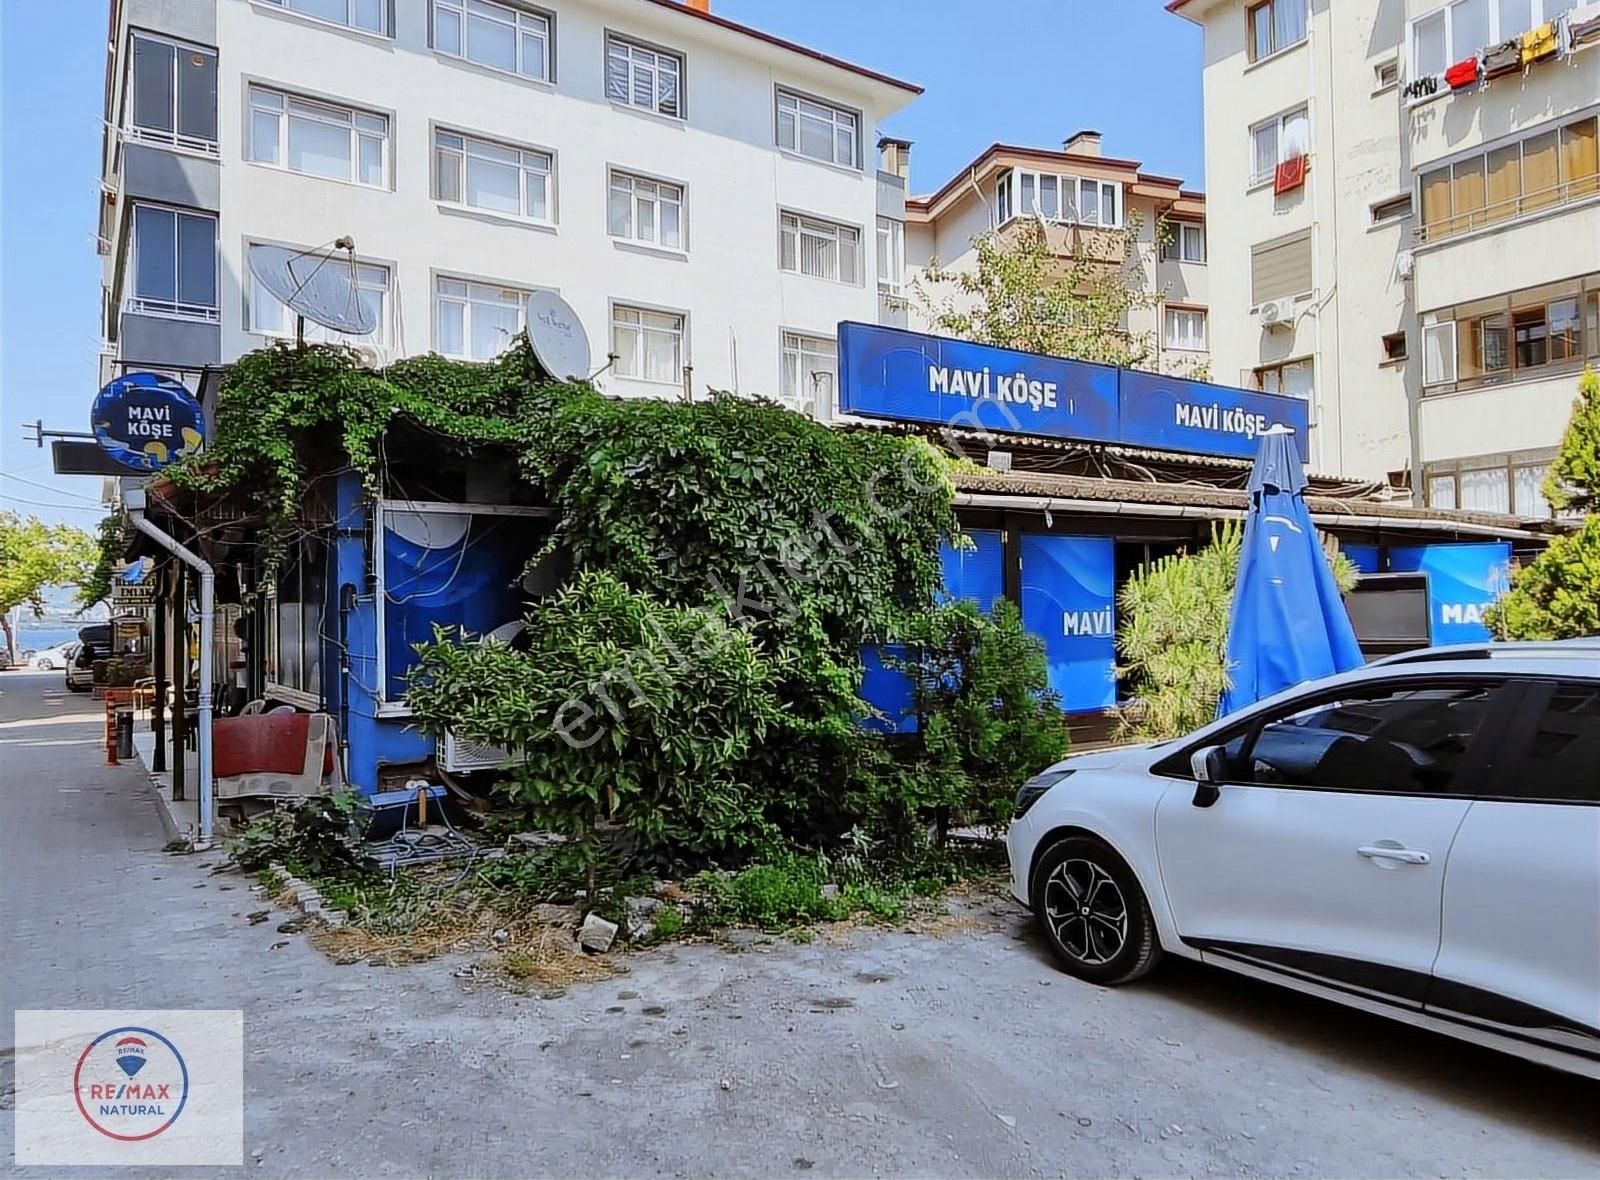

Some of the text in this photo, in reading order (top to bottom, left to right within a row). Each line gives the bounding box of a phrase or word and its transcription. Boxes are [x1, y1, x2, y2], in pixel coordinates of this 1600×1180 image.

[928, 366, 1057, 412] MAVİ KÖŞE
[128, 405, 170, 421] MAVİ
[128, 419, 173, 439] KÖŞE
[1176, 403, 1268, 439] MAVİ KÖŞE
[1063, 604, 1111, 636] MAVİ
